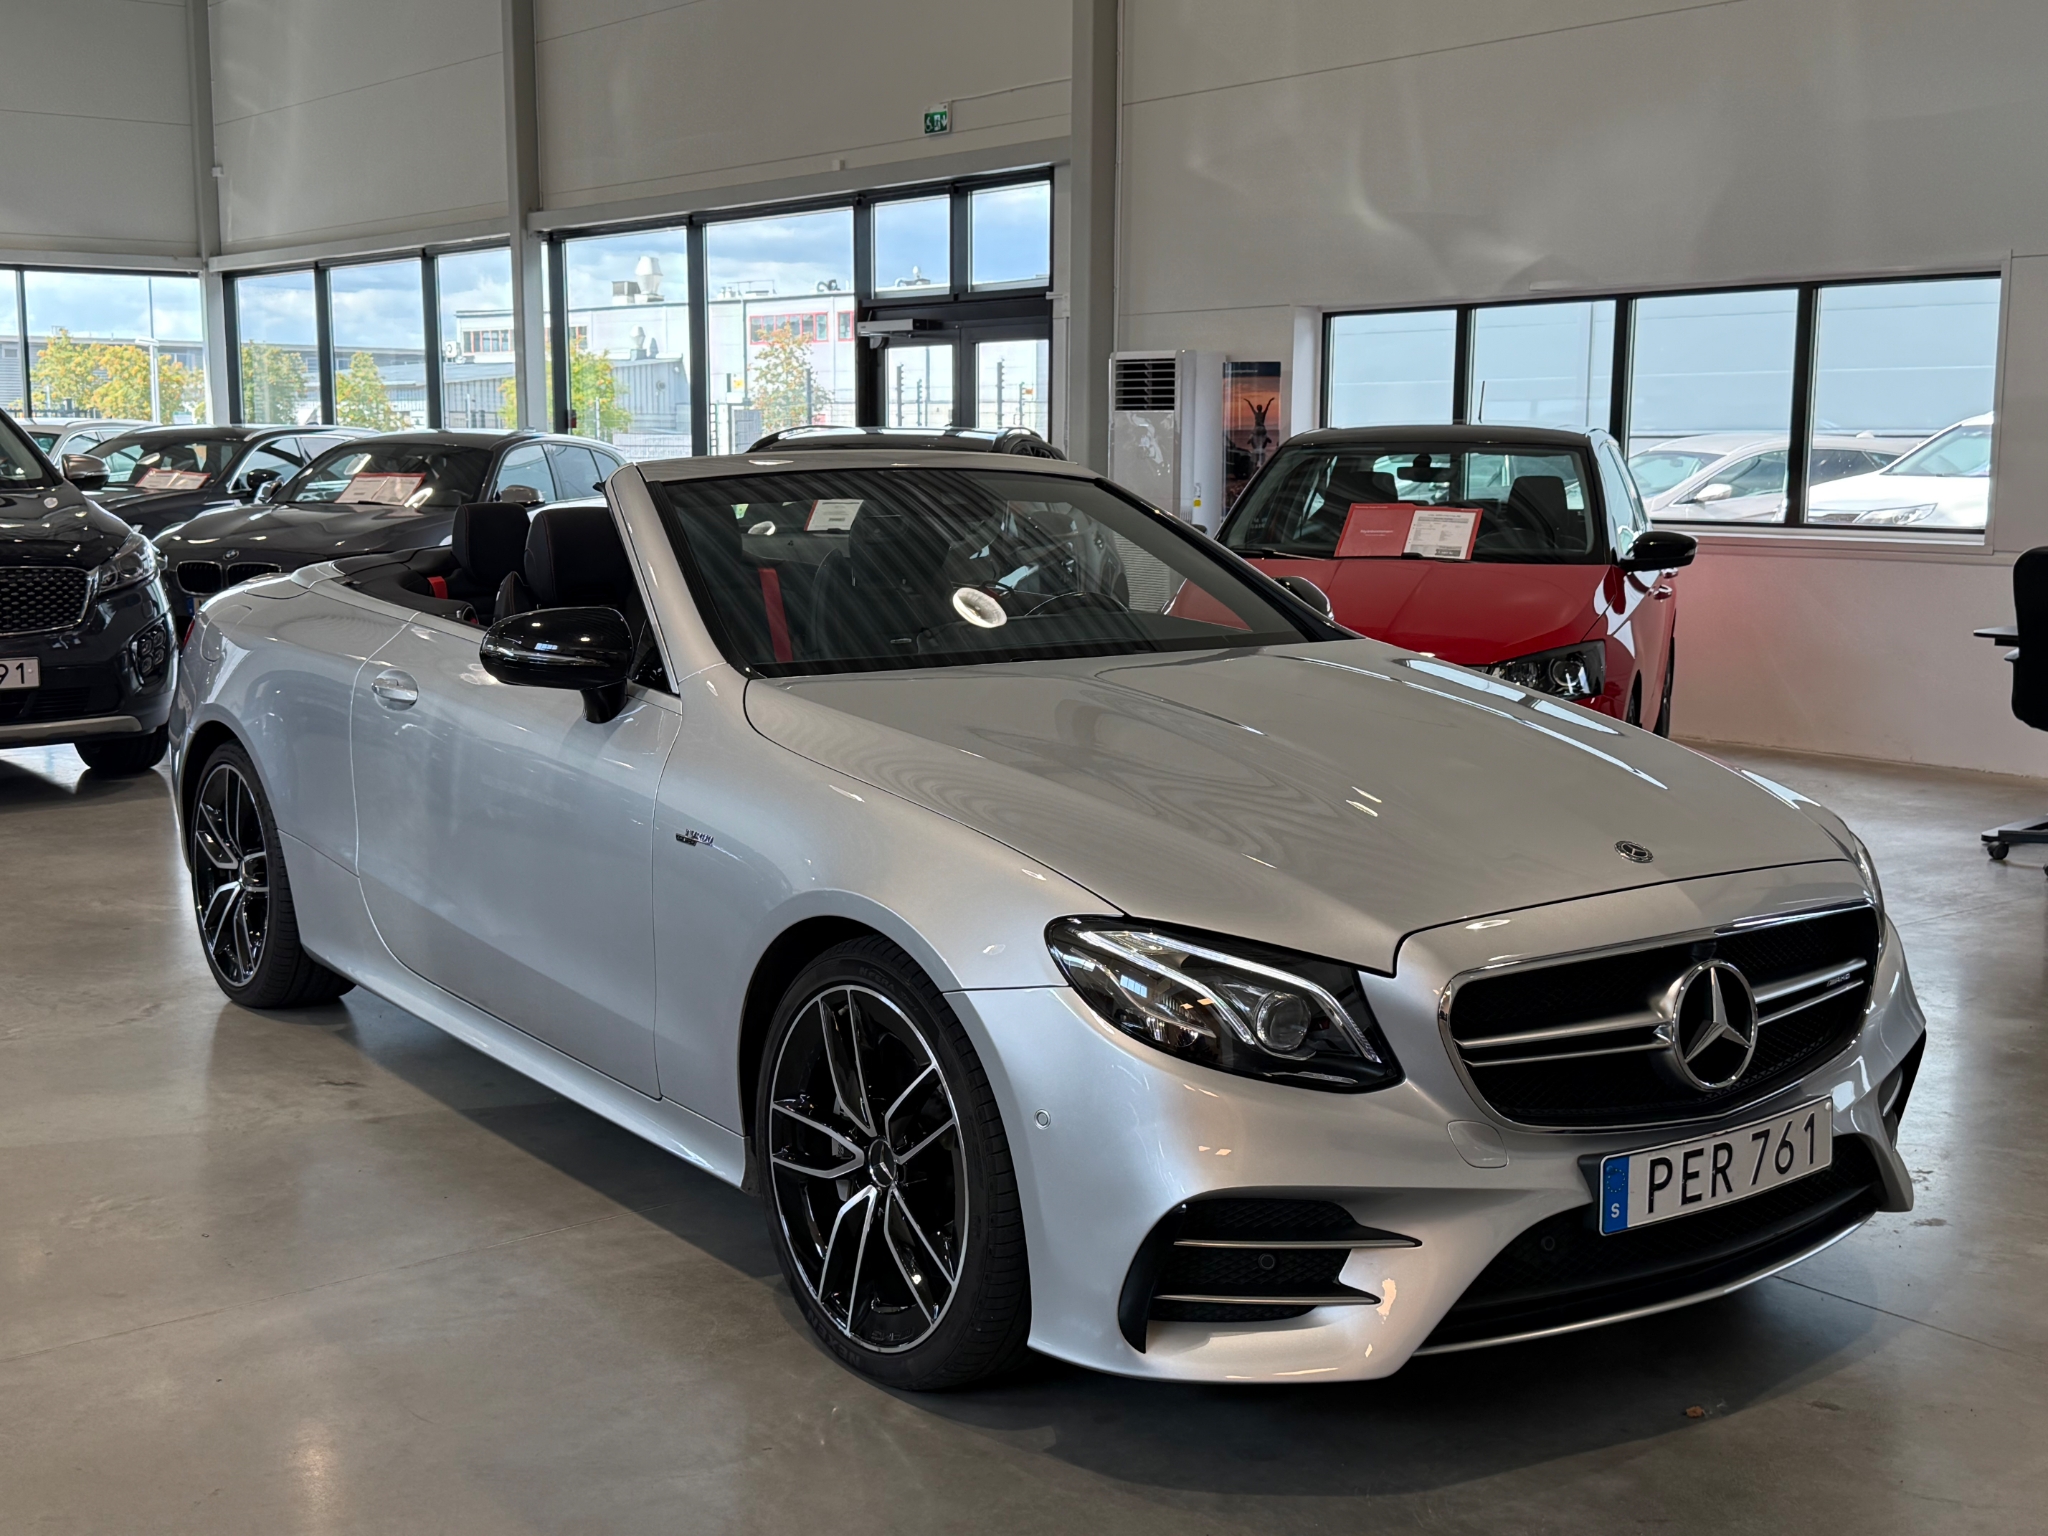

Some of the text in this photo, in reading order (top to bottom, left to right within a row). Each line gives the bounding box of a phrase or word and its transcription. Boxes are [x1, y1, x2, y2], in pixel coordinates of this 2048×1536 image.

[1647, 1111, 1815, 1214] PER 761
[1610, 1202, 1620, 1218] S
[806, 1309, 860, 1366] NEXEN
